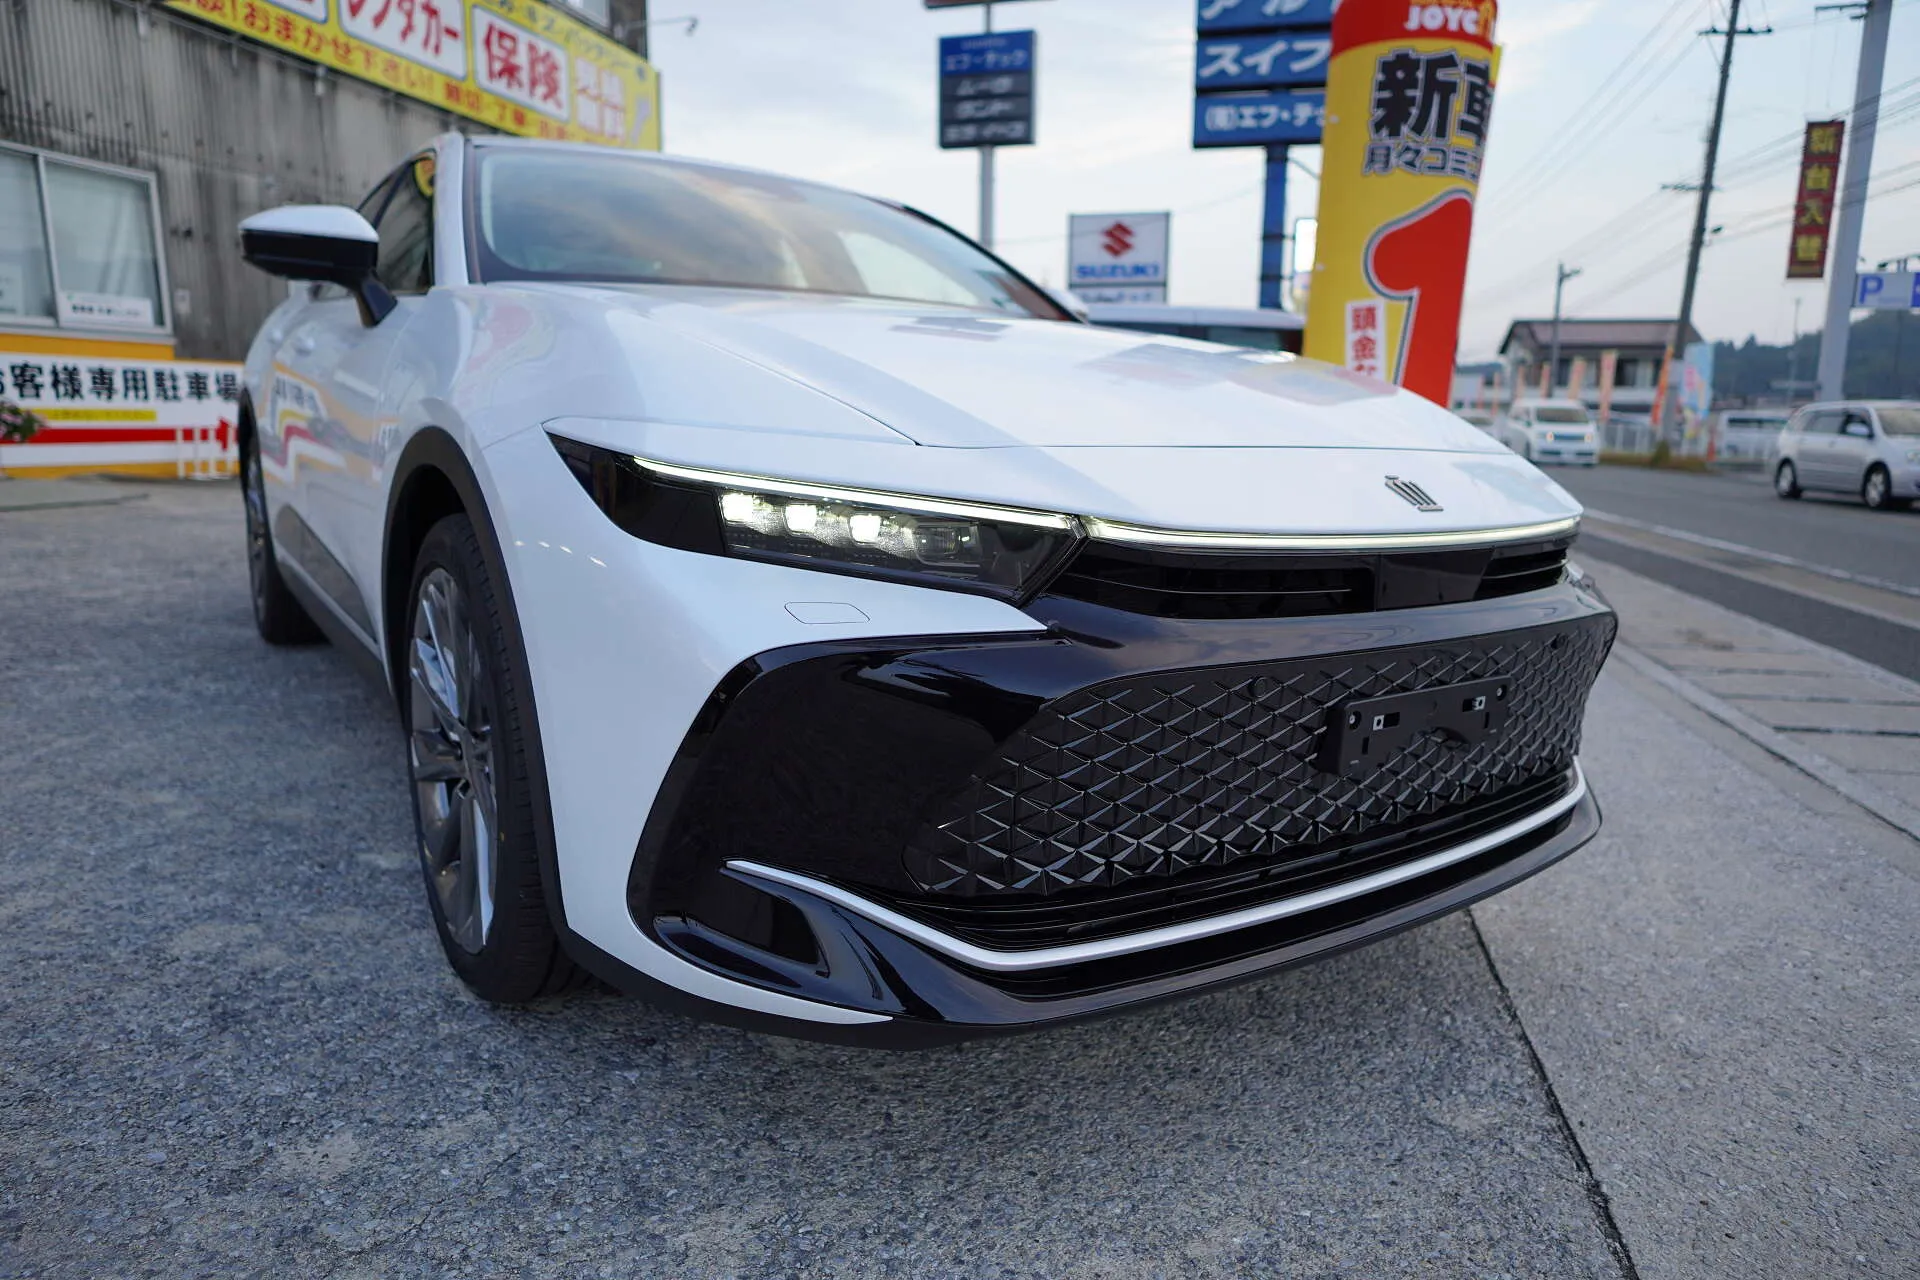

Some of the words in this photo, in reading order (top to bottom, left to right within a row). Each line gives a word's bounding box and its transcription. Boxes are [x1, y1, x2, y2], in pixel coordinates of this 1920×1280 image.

[484, 22, 563, 110] 保険
[1076, 263, 1159, 279] SUZUKI
[1858, 275, 1885, 305] P
[0, 360, 241, 401] 客様専用駐車場
